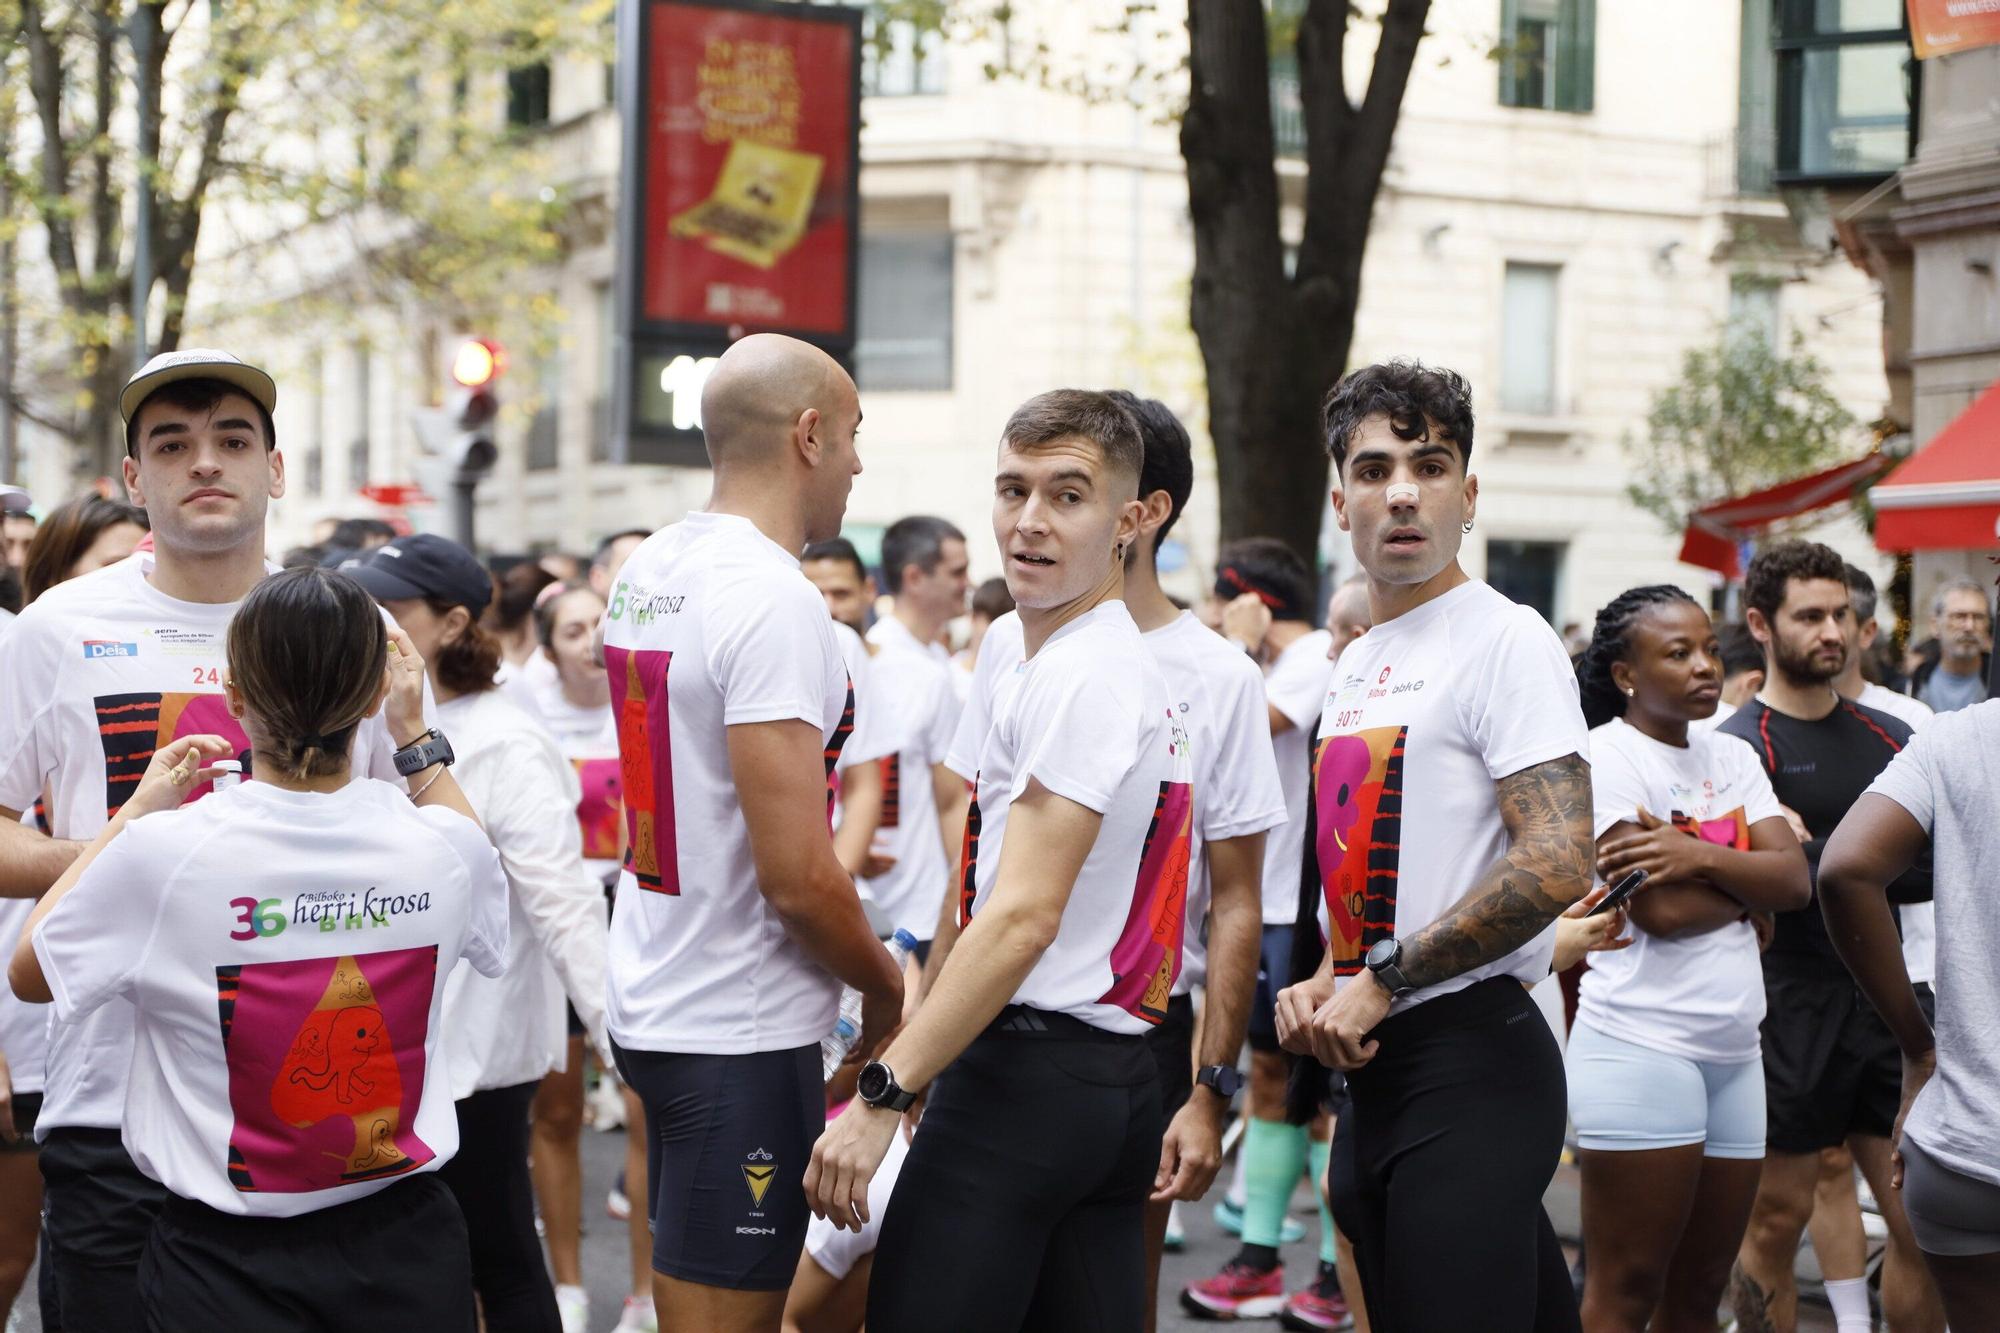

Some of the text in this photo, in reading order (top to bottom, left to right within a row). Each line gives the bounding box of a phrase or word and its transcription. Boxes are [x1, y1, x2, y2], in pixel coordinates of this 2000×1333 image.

[606, 582, 628, 620] 6
[92, 644, 129, 657] Deia
[293, 887, 431, 924] herri krosa
[305, 890, 345, 903] Bilboko
[229, 896, 288, 941] 36
